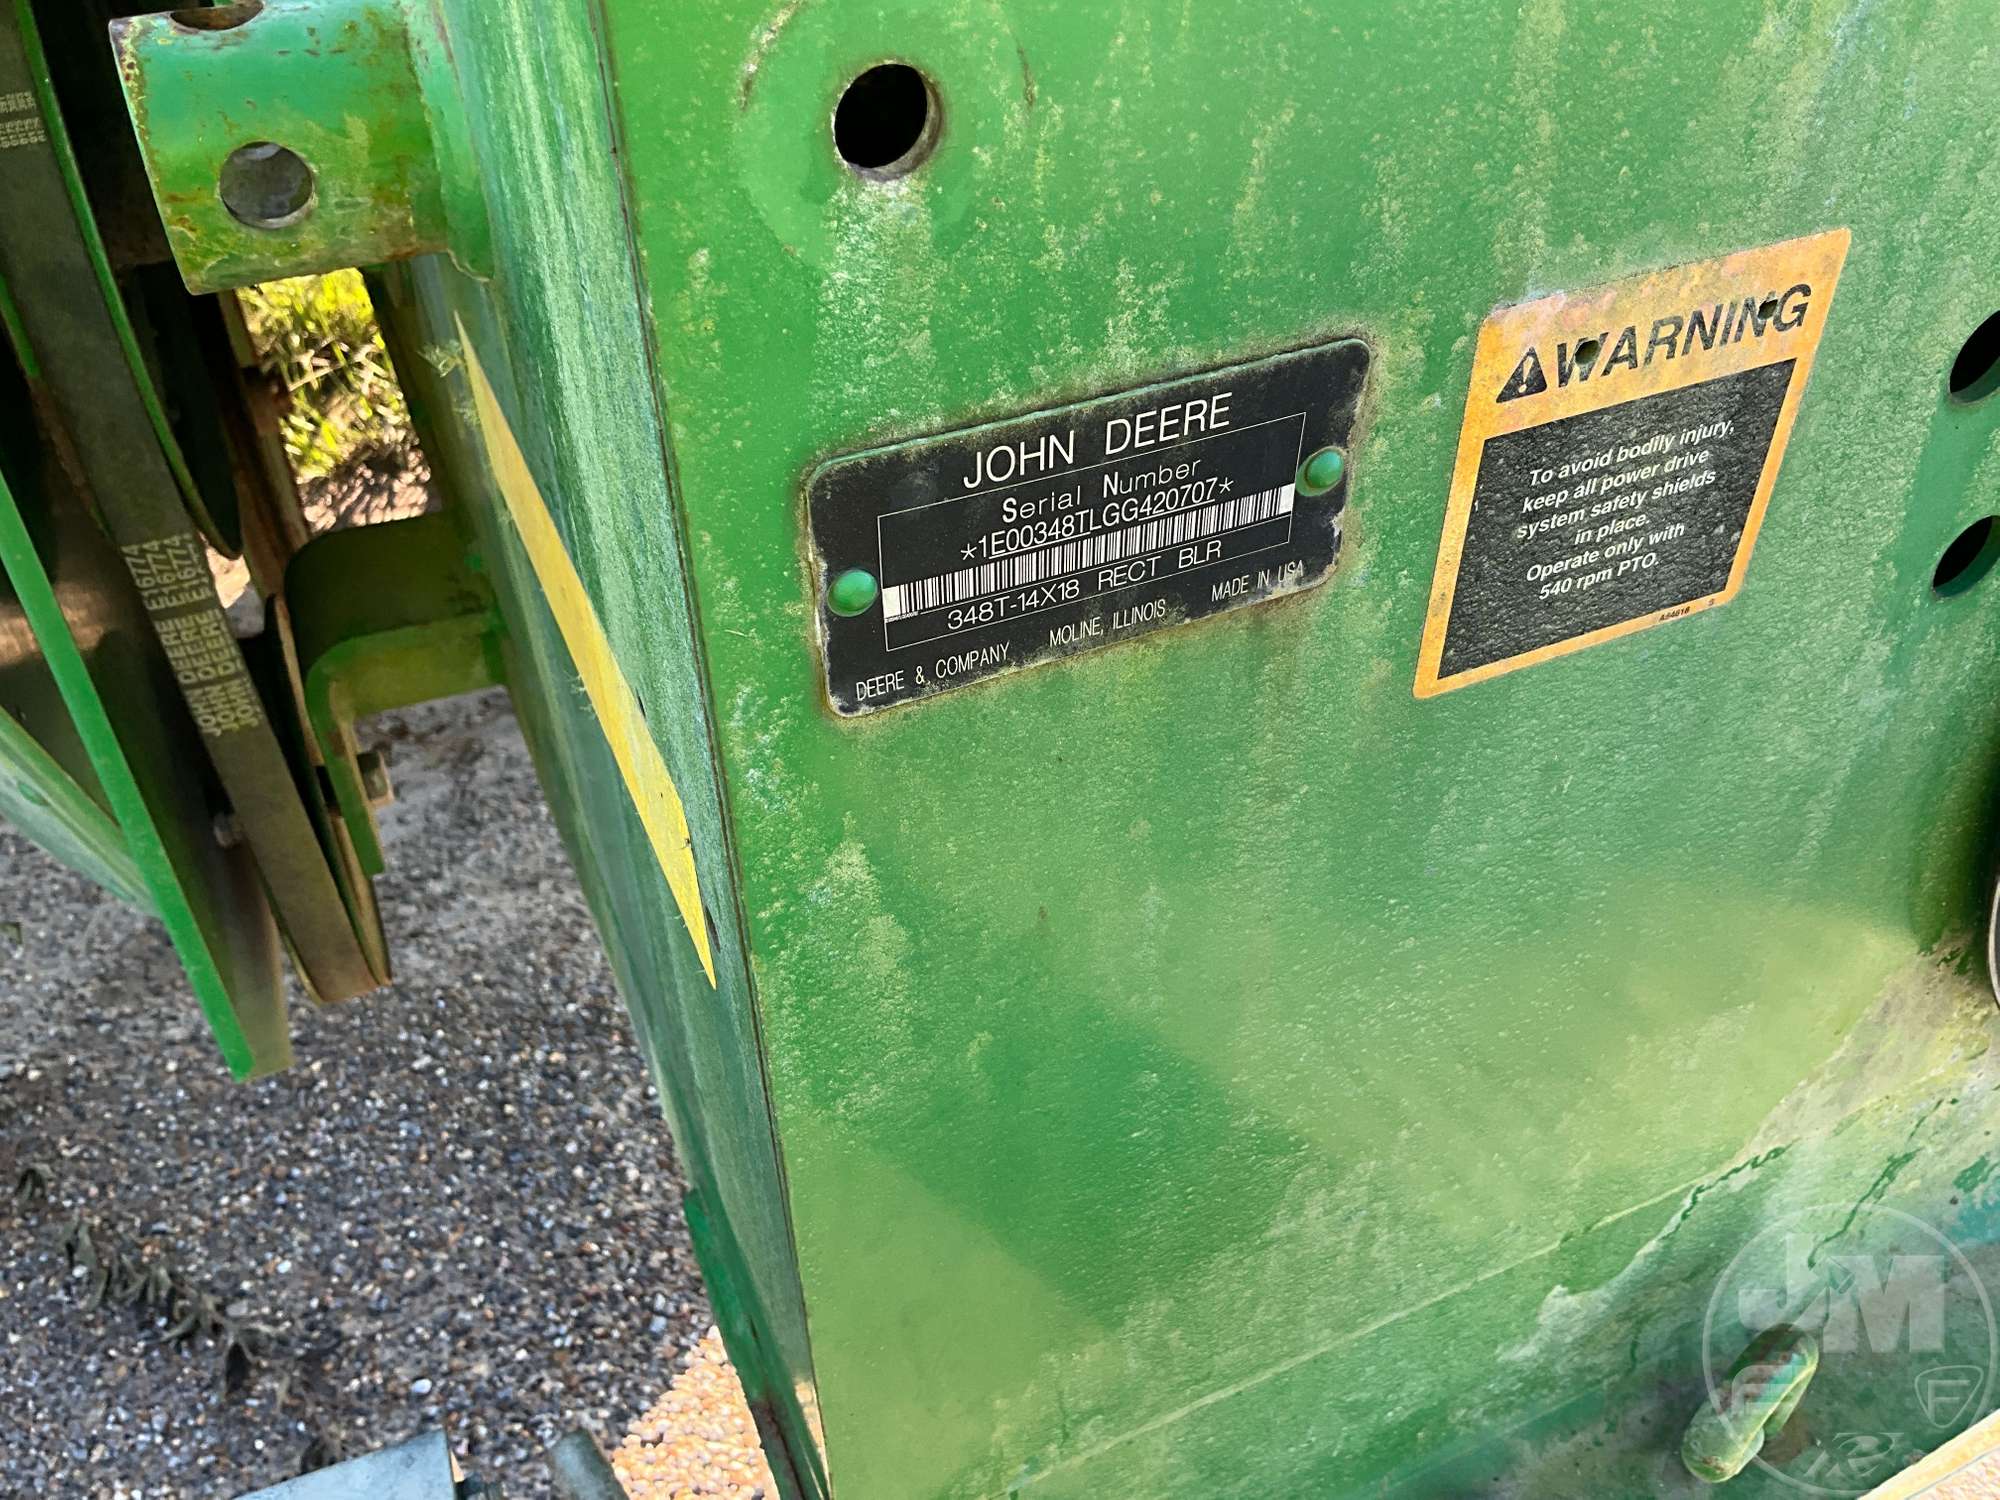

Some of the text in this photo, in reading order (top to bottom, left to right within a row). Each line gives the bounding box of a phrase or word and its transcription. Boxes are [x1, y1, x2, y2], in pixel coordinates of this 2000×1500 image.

[1557, 284, 1812, 388] WARNING
[963, 392, 1233, 489] JOHN DEERE
[1529, 420, 1735, 487] To avoid bodily injury,
[1002, 458, 1201, 523] Serial Number
[1517, 469, 1716, 540] system safety shields
[1521, 449, 1709, 514] keep all power drive
[1526, 522, 1685, 582] Operate only with
[1574, 512, 1651, 545] in place.
[947, 539, 1222, 630] 348T-14X18 RECT BLR
[1211, 559, 1304, 602] MADE IN USA
[1539, 552, 1660, 601] 540 rpm PTO.
[153, 618, 199, 684] DEERE
[174, 617, 219, 680] DEERE
[195, 611, 237, 675] DEERE
[1050, 598, 1166, 648] MOLINE, ILLINOIS
[856, 641, 1010, 701] DEERE & COMPANY
[184, 687, 221, 737] JOHN
[203, 684, 240, 733] JOHN
